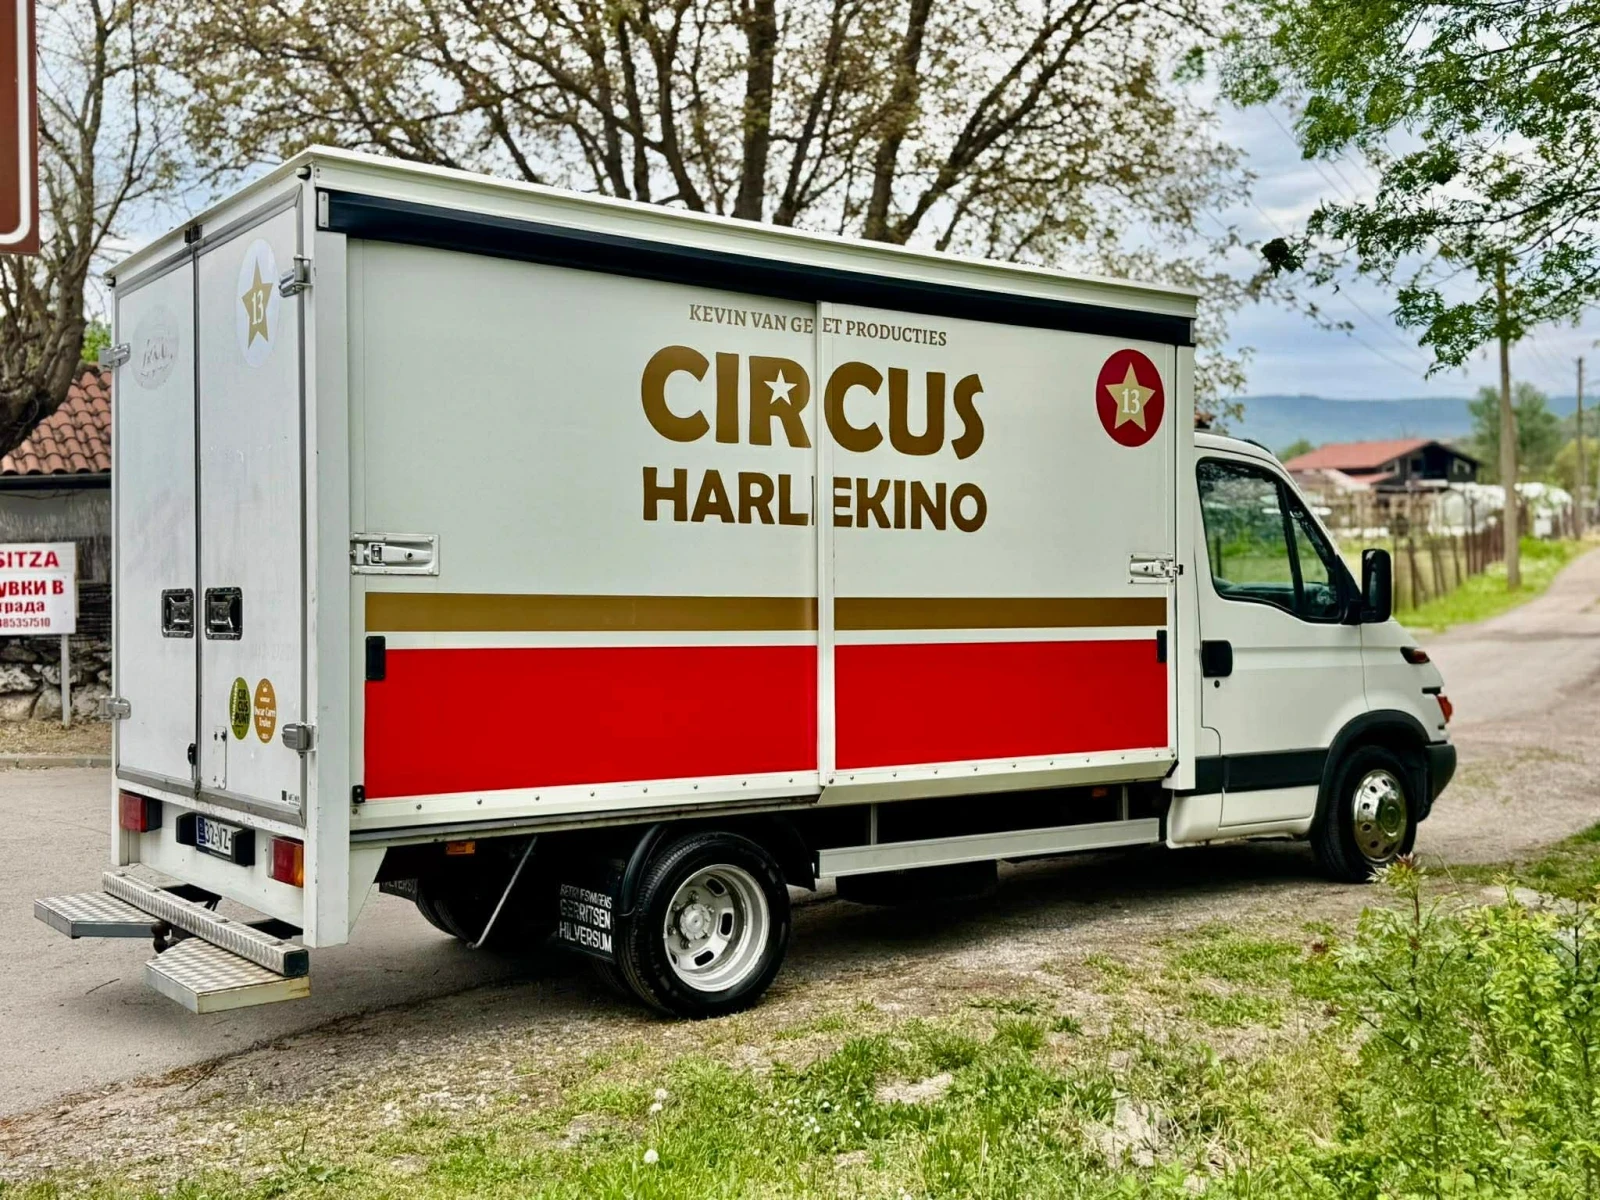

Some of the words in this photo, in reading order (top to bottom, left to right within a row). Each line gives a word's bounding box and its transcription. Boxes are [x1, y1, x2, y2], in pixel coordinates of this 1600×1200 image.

[251, 290, 264, 325] 13
[689, 304, 747, 327] KEVIN
[751, 312, 788, 332] VAN
[846, 320, 947, 347] PRODUCTIES
[641, 345, 985, 460] CIRCUS
[1121, 388, 1141, 415] 13
[642, 466, 988, 533] HARLEKINO
[559, 921, 613, 954] HILVERSUM
